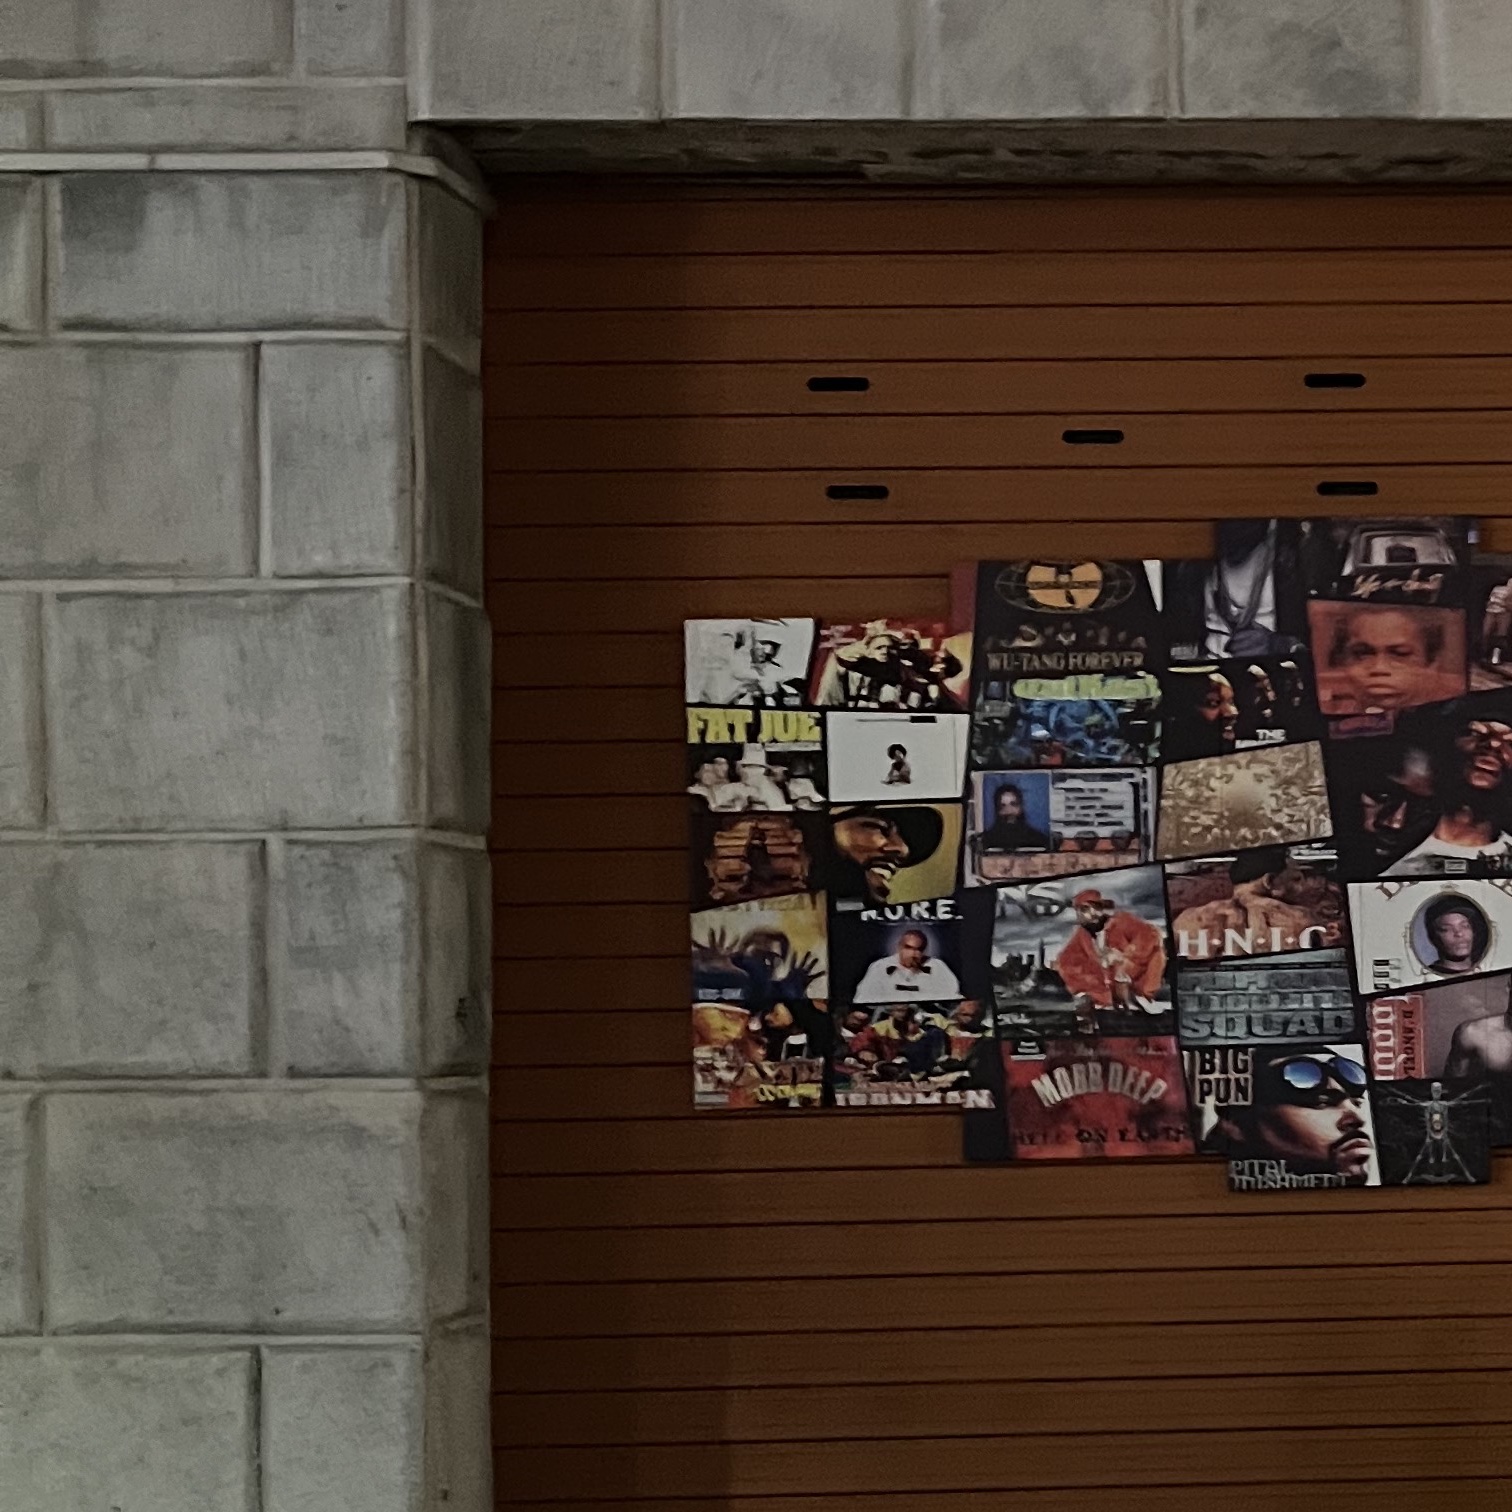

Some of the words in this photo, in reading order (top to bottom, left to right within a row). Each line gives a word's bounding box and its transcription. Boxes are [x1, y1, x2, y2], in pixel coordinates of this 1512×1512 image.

[687, 708, 753, 744] FAT
[1180, 1009, 1355, 1040] SQUAD
[1198, 1048, 1250, 1075] BIG
[1107, 1061, 1168, 1105] DEEP
[1198, 1077, 1250, 1104] PUN
[1230, 1159, 1288, 1177] PITAL
